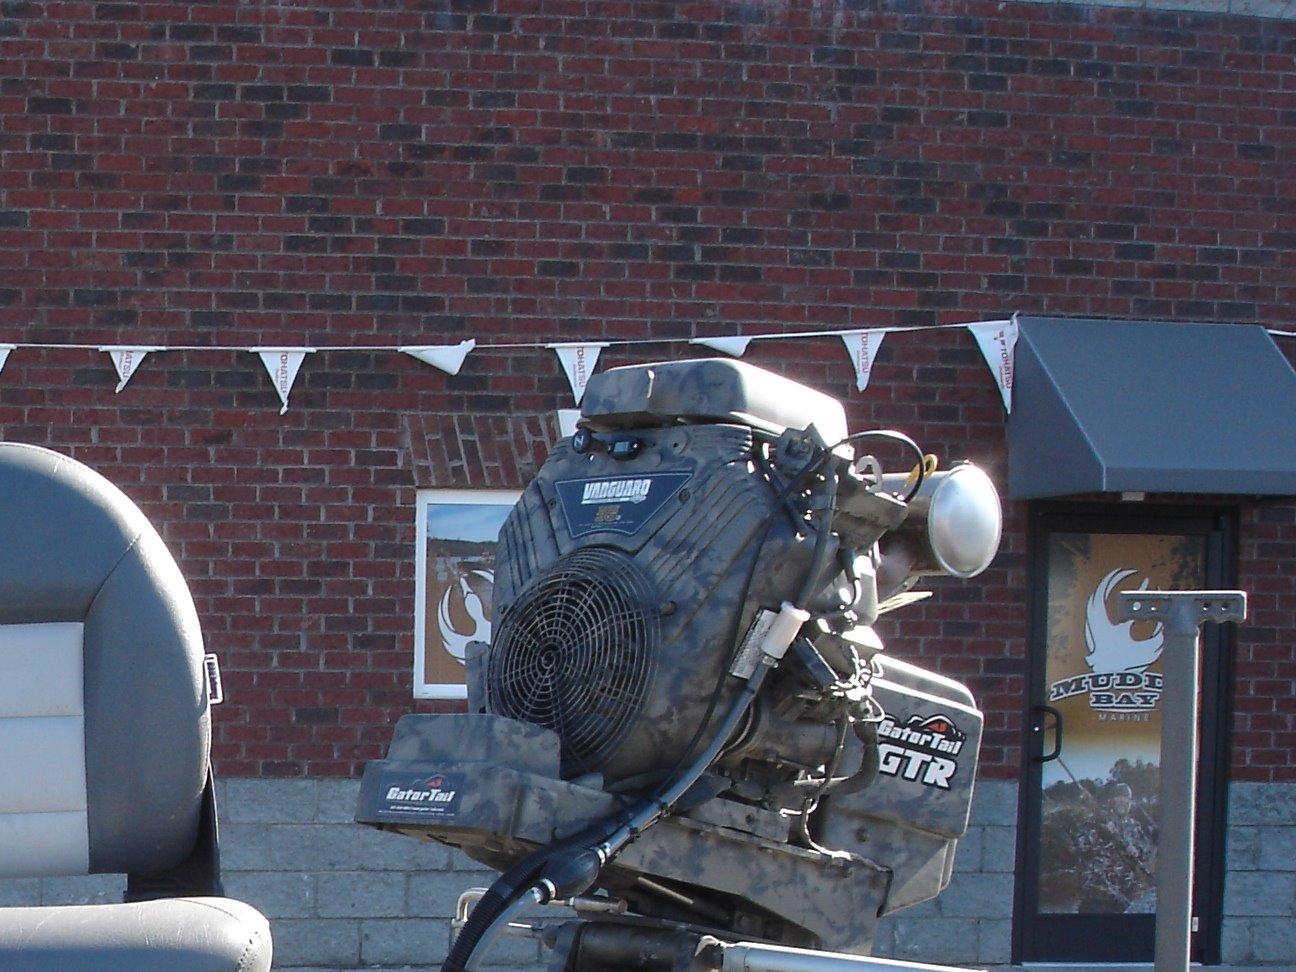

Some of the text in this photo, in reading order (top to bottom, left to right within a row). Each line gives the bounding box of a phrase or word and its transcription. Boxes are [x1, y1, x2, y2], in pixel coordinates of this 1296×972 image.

[583, 480, 652, 499] VANGUARD
[1050, 671, 1163, 701] MUDD
[1090, 692, 1159, 707] BAY
[1098, 713, 1151, 722] MARINE
[877, 719, 963, 755] GatorTail
[877, 743, 956, 788] GTR
[386, 787, 455, 802] GatorTail
